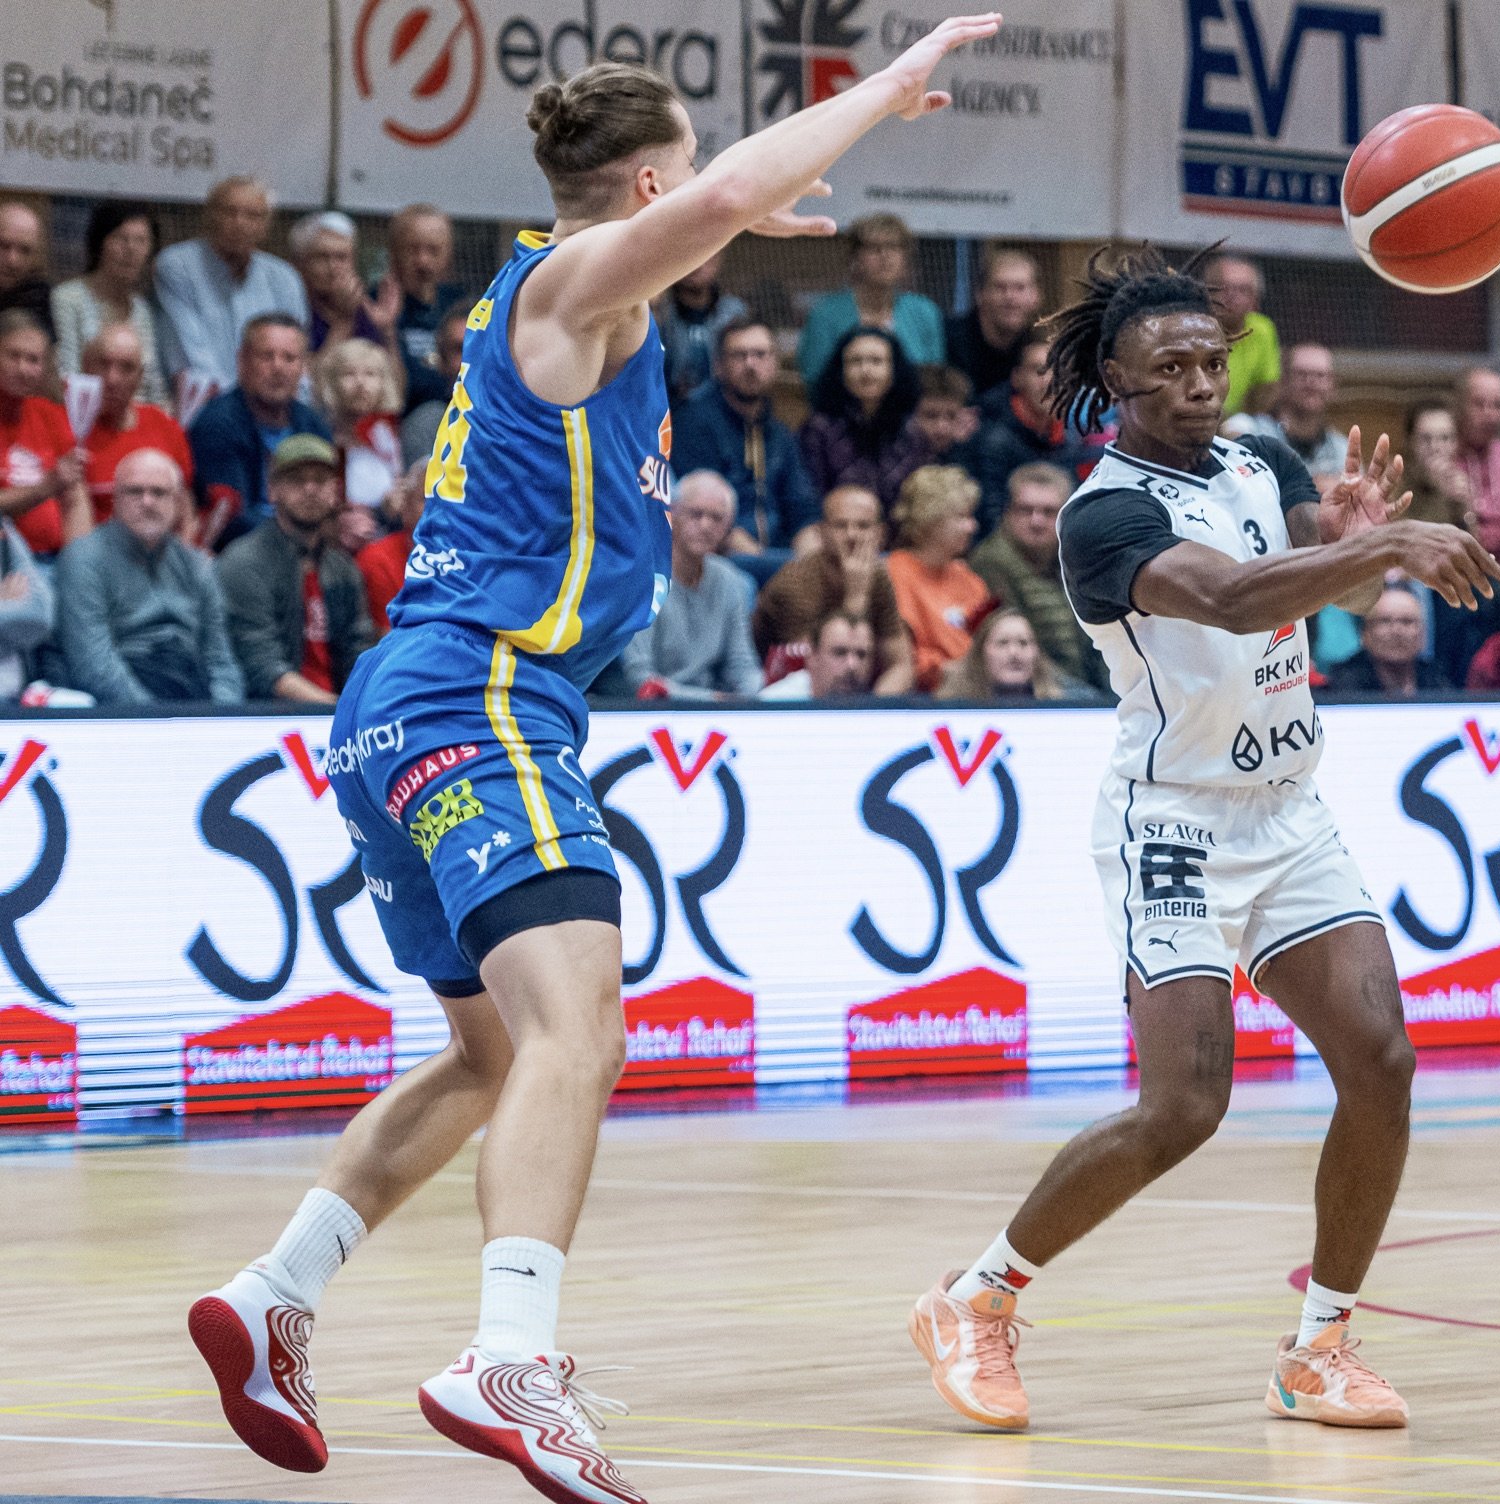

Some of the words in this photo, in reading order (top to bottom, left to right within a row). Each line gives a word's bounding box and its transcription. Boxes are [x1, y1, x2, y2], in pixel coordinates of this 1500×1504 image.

[1183, 0, 1385, 150] EVT
[151, 124, 216, 174] Spa
[1242, 518, 1269, 556] 3
[1253, 660, 1282, 688] BK
[1285, 651, 1304, 677] KV
[1143, 823, 1217, 847] SLAVIA
[1144, 900, 1207, 921] enteria
